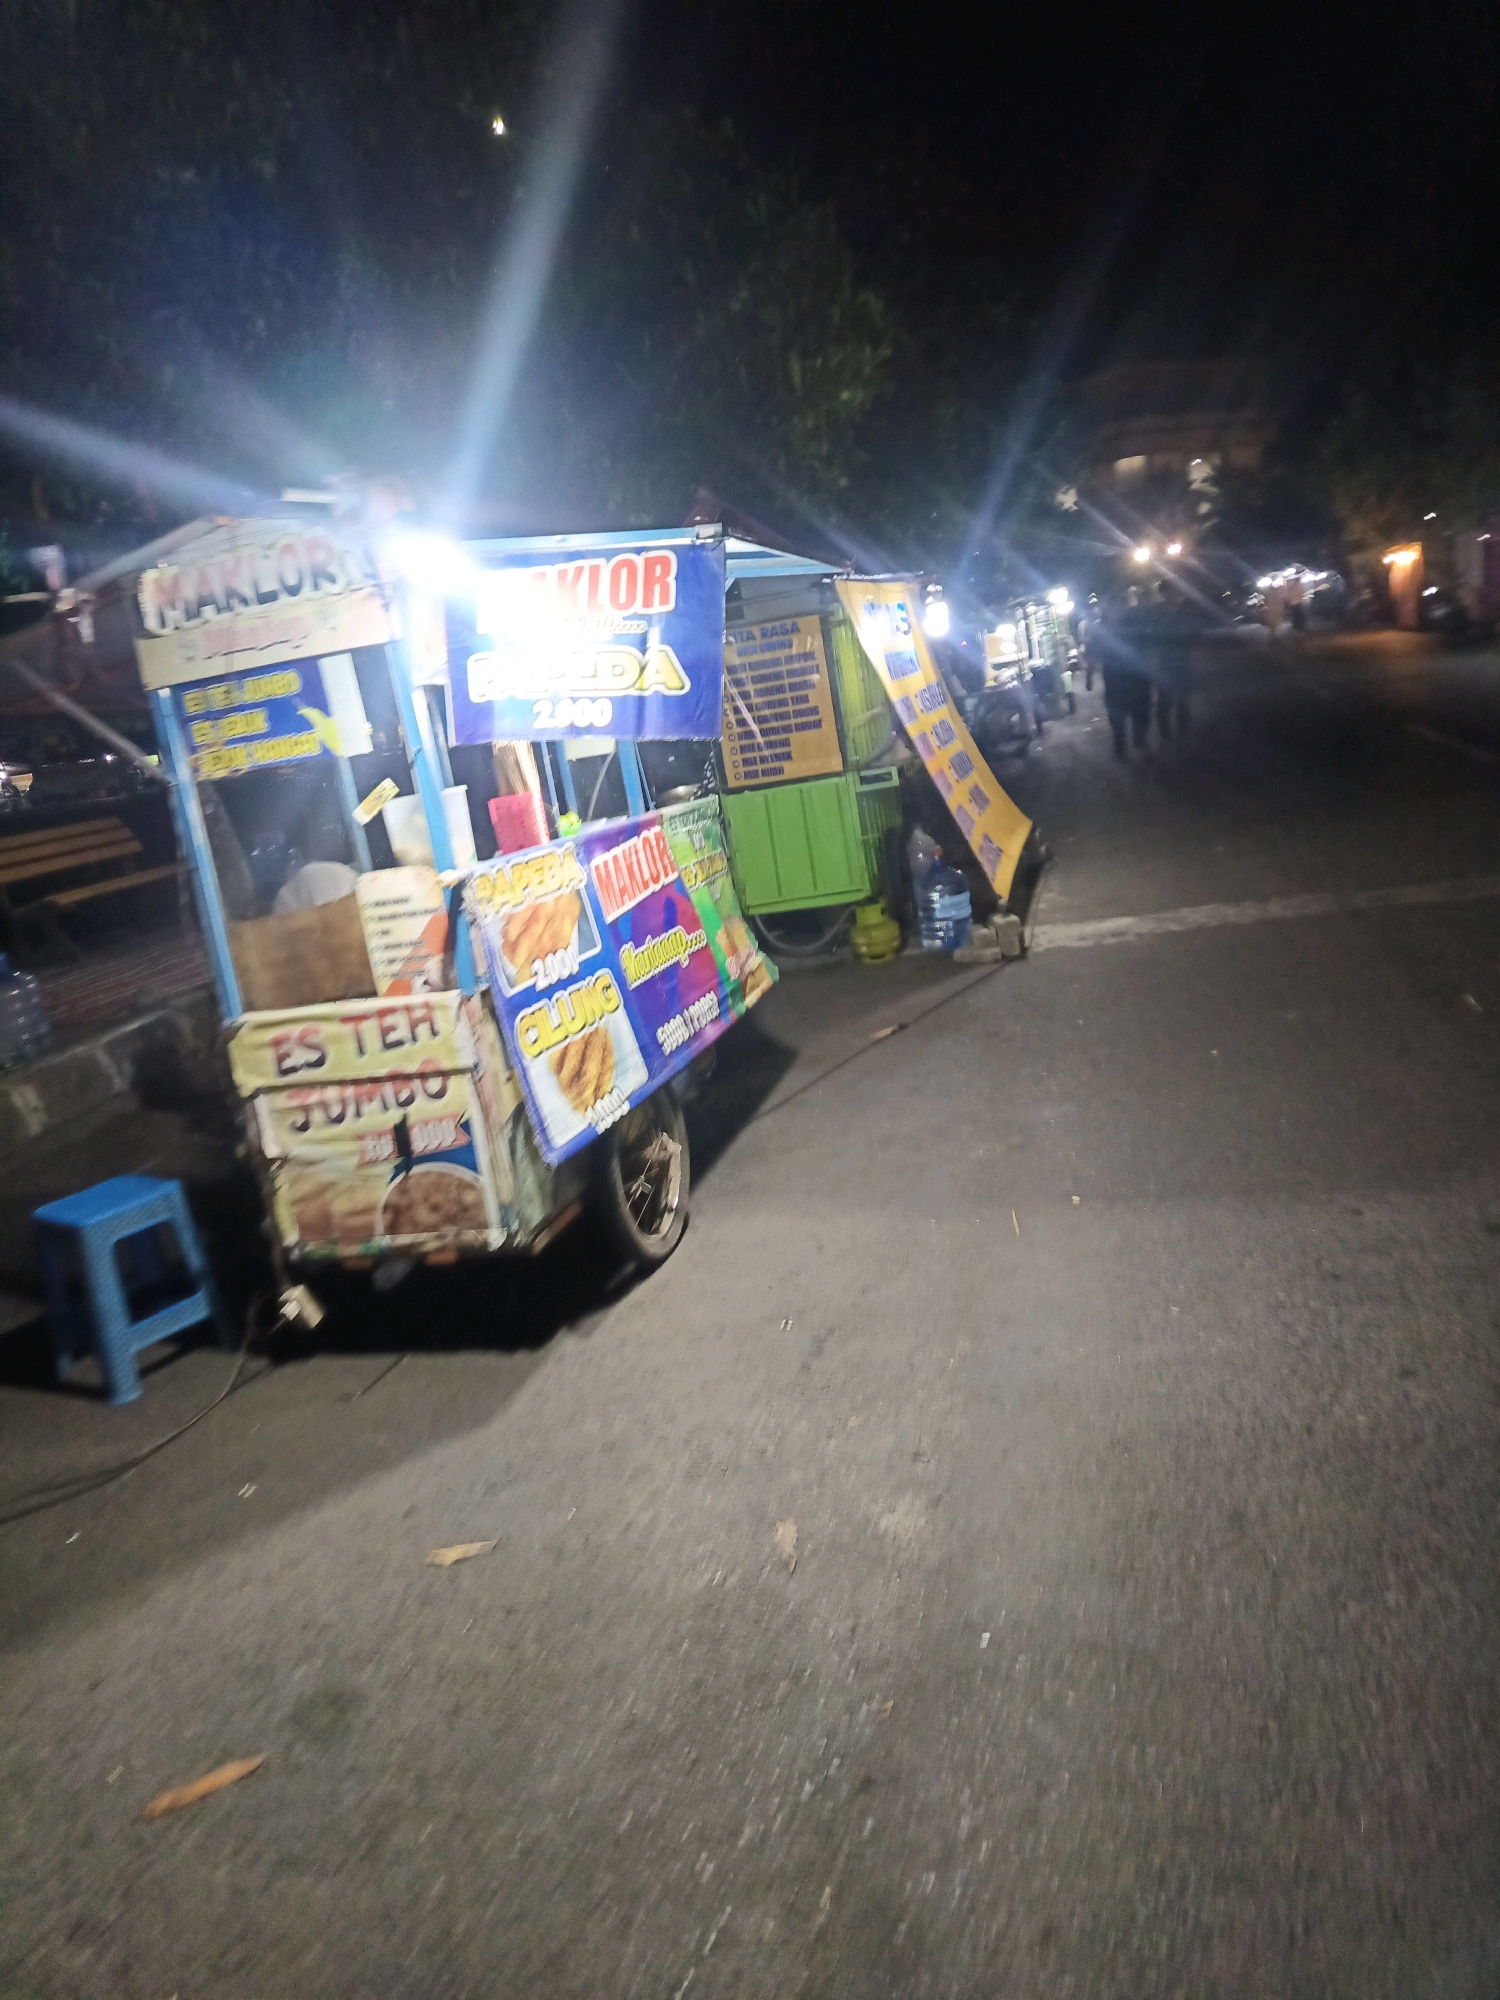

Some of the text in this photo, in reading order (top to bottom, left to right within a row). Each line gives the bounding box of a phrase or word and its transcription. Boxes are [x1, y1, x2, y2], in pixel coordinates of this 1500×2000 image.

[760, 622, 800, 639] RASA
[476, 850, 583, 918] PAPEDA
[592, 828, 680, 920] MAKLOR
[270, 1000, 440, 1078] ES TEH
[517, 972, 619, 1056] CILUNG
[286, 1057, 452, 1131] JUMBO
